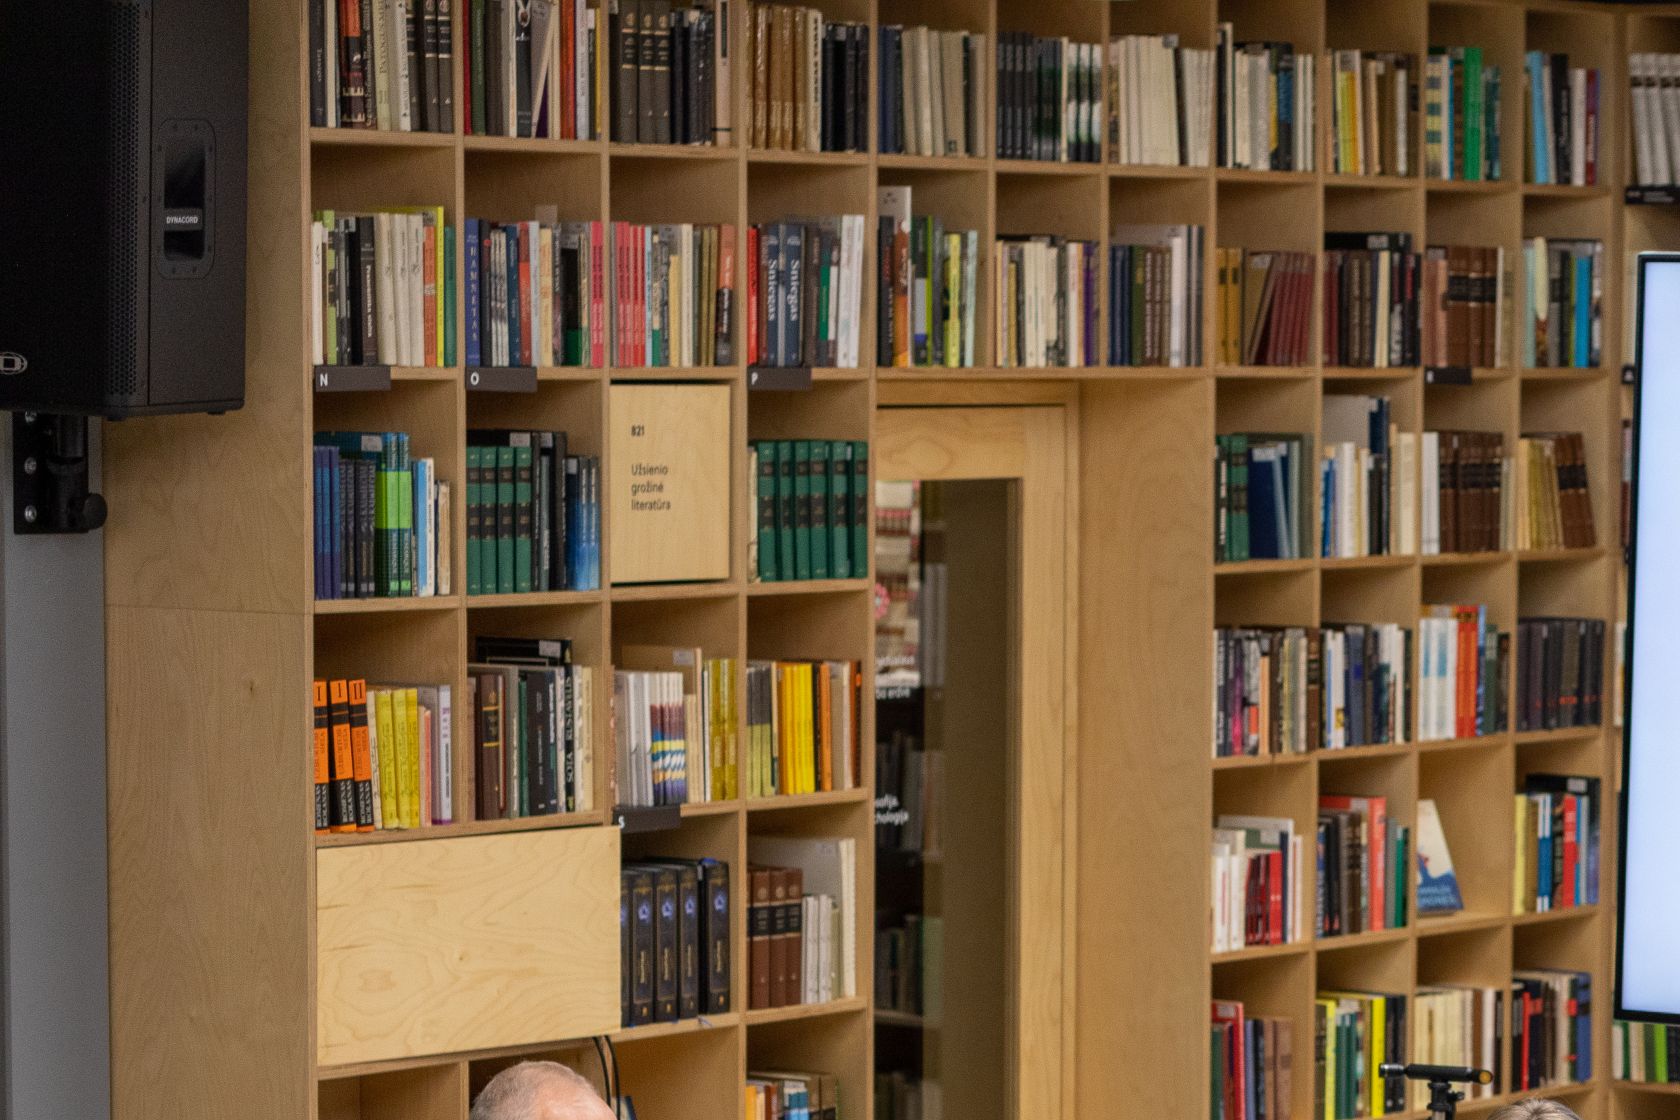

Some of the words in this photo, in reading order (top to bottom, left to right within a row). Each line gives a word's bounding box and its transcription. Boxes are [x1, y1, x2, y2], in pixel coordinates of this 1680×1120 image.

[166, 216, 198, 224] DYNACORD
[787, 260, 799, 321] Sniegas
[319, 374, 328, 386] N
[631, 425, 645, 436] 821
[631, 463, 669, 477] Užsienio
[631, 481, 664, 496] grožinė
[631, 498, 671, 511] literatūra
